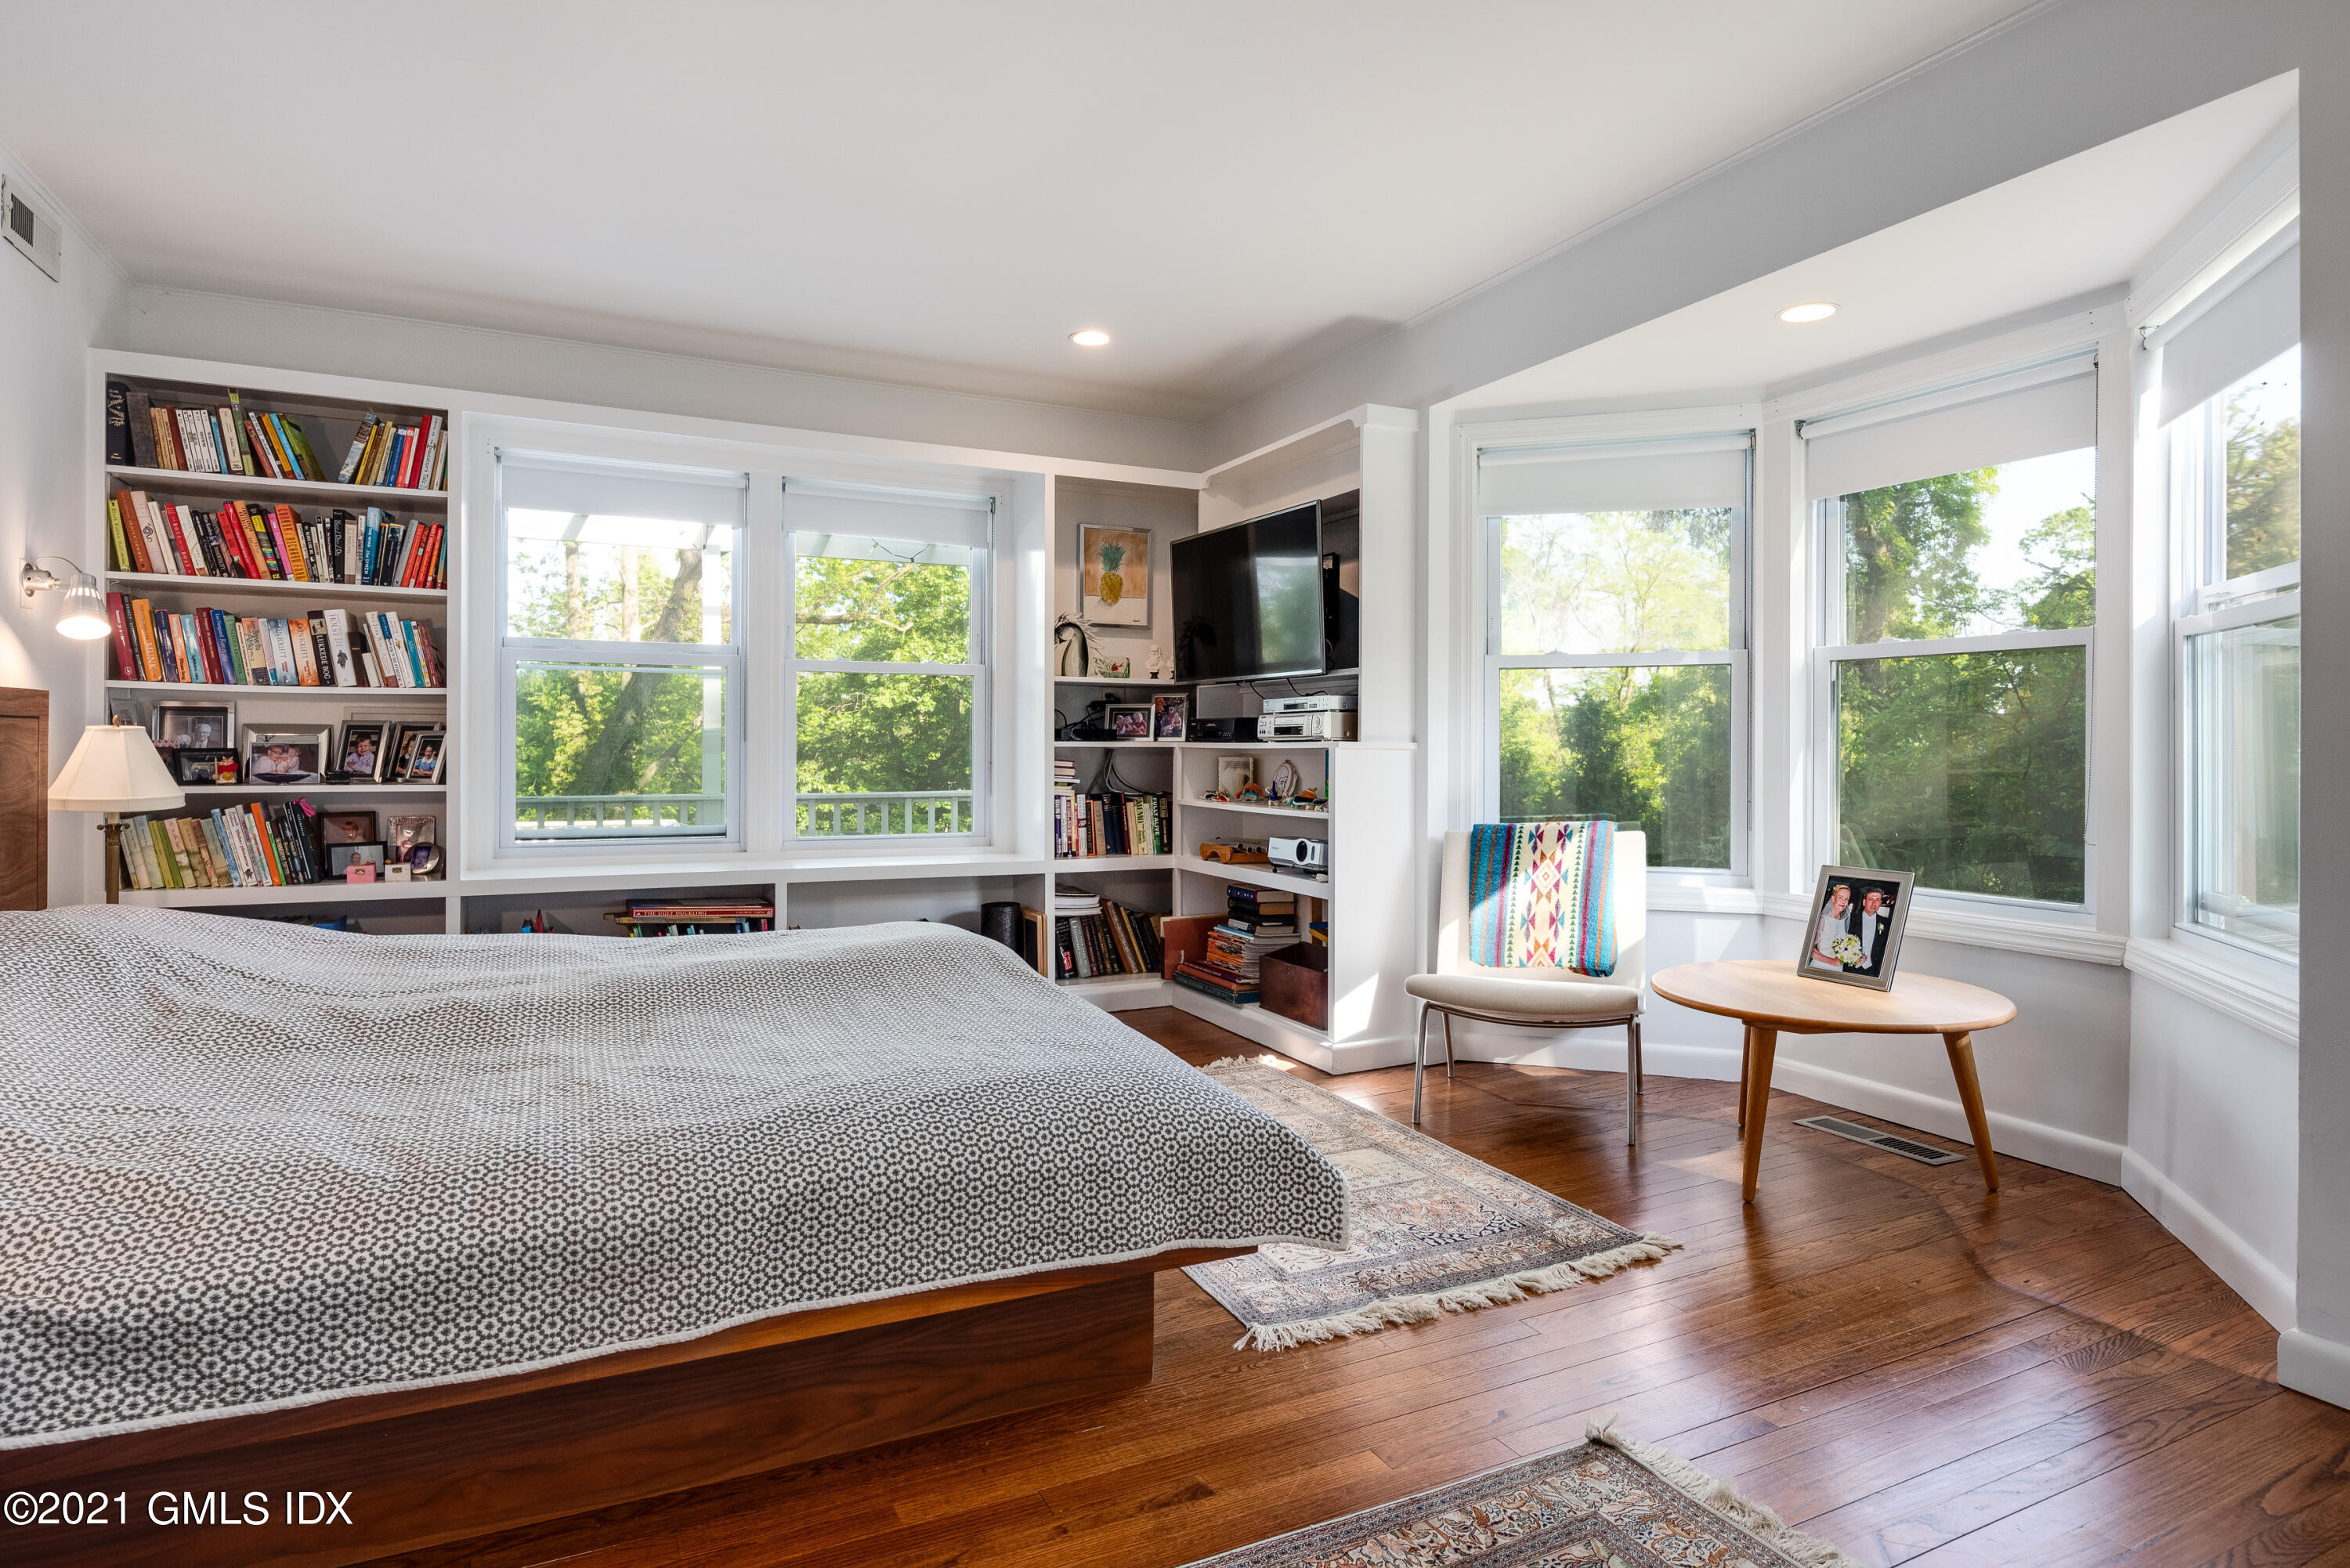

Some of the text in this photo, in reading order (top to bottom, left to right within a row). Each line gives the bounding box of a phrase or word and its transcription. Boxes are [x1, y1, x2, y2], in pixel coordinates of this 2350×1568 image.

[173, 523, 182, 539] BOYS
[181, 551, 190, 567] BOAT
[329, 614, 340, 637] HOLST
[145, 642, 157, 670] MUNK
[277, 638, 287, 659] FOLLETT
[299, 638, 309, 659] FOLLETT
[316, 634, 328, 665] LUKKEDE
[322, 666, 331, 680] BOG
